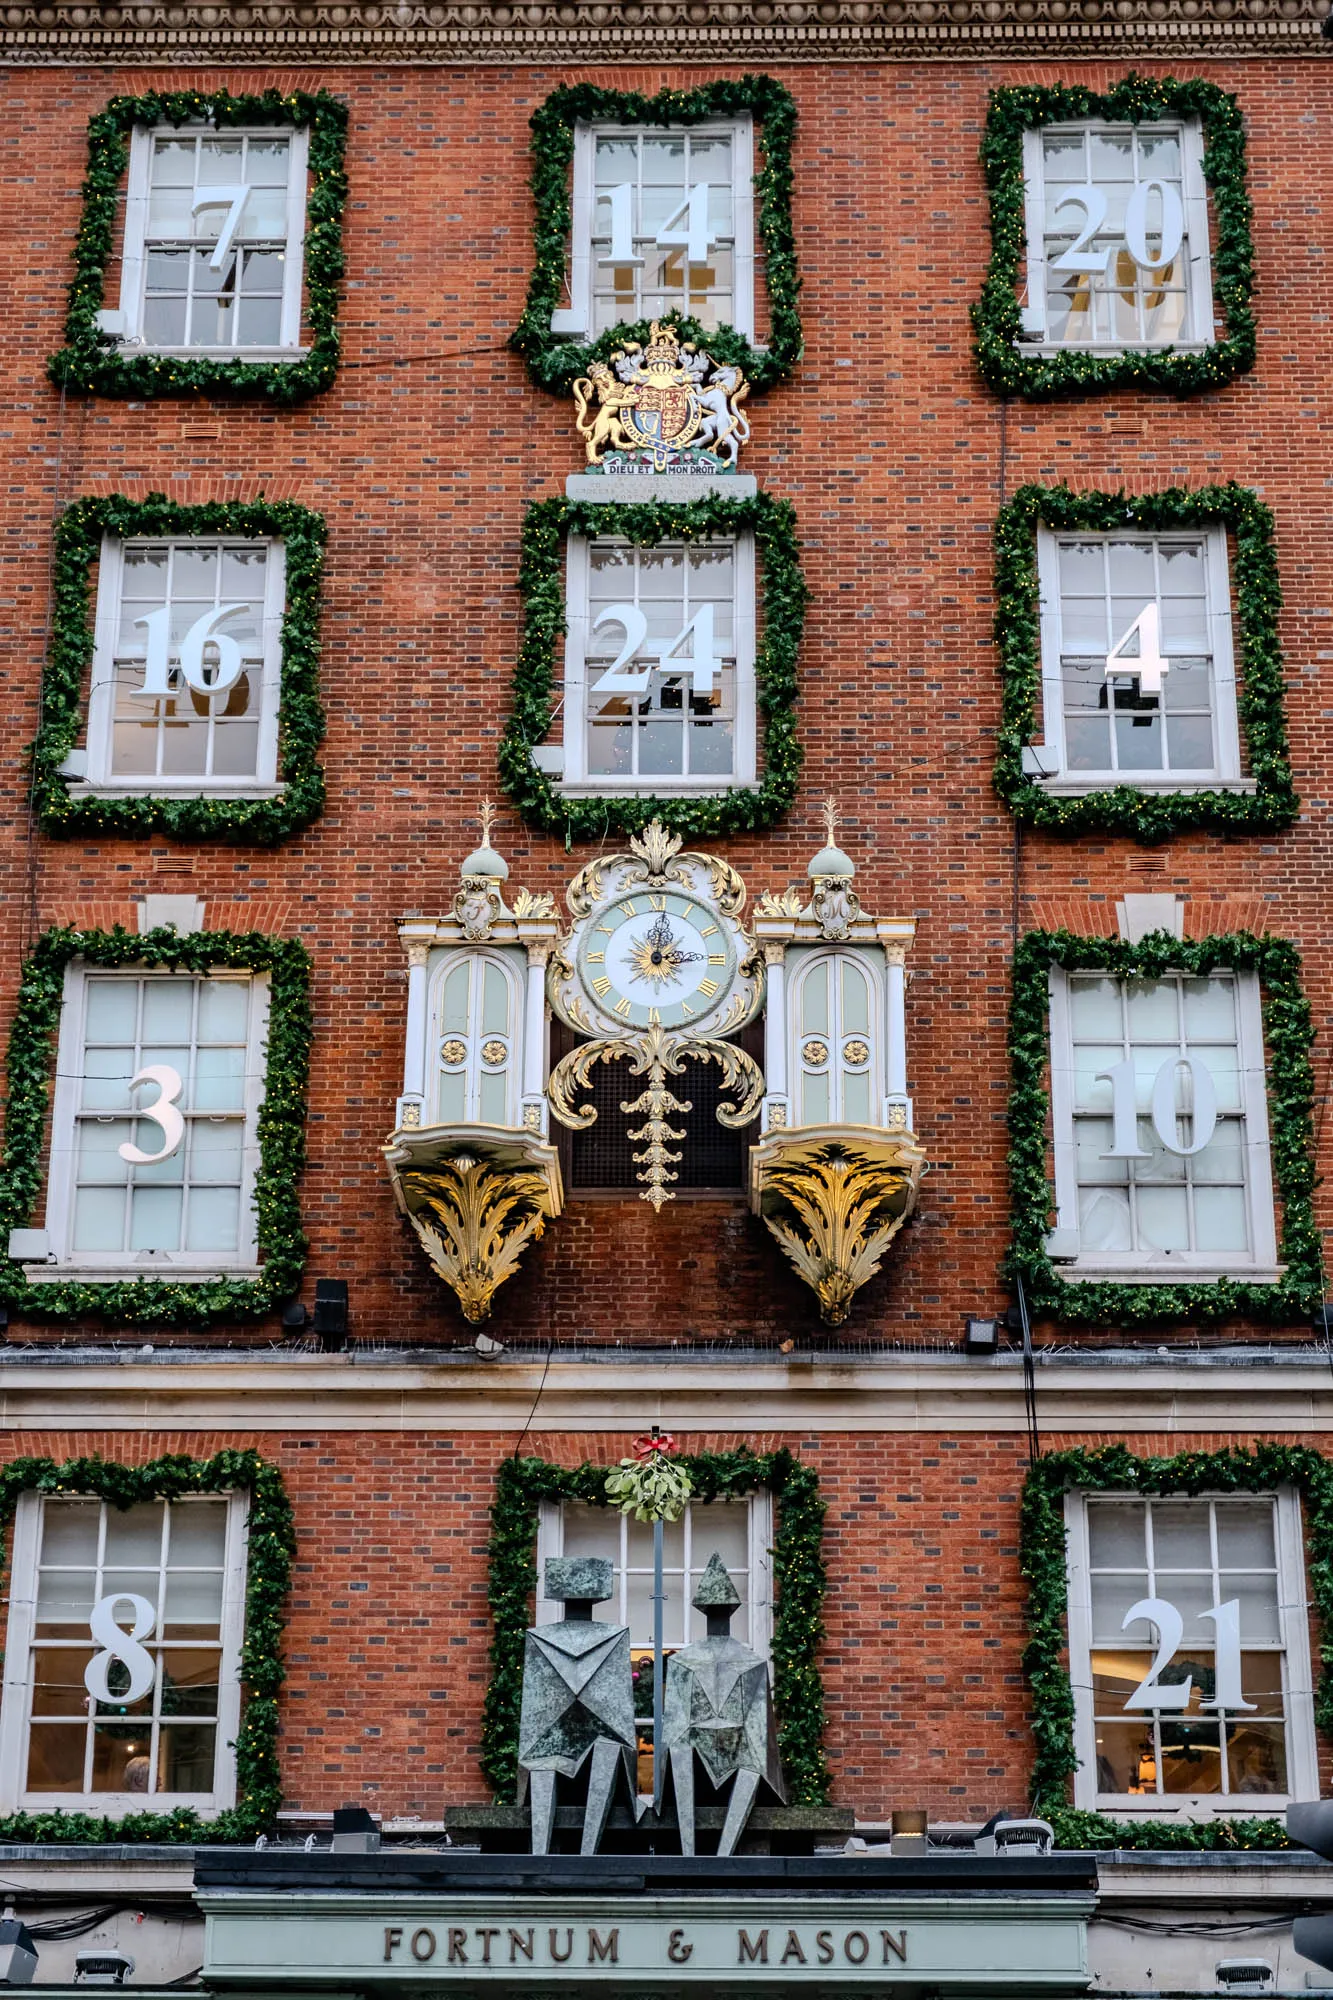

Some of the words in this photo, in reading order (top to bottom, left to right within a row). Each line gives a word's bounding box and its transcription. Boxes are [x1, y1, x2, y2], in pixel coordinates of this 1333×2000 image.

[191, 184, 250, 273] 7
[597, 182, 716, 268] 14
[1053, 178, 1184, 275] 20
[609, 465, 633, 474] DIEU
[638, 465, 650, 474] ET
[668, 465, 688, 474] MON
[690, 465, 715, 474] DROIT
[129, 602, 250, 701] 16
[590, 603, 722, 697] 24
[1105, 602, 1169, 698] 4
[118, 1064, 184, 1166] 3
[1095, 1056, 1217, 1160] 10
[84, 1592, 156, 1705] 8
[1120, 1598, 1258, 1711] 21
[384, 1927, 619, 1962] FORTNUM
[668, 1929, 692, 1962] &
[737, 1929, 909, 1964] MASON
